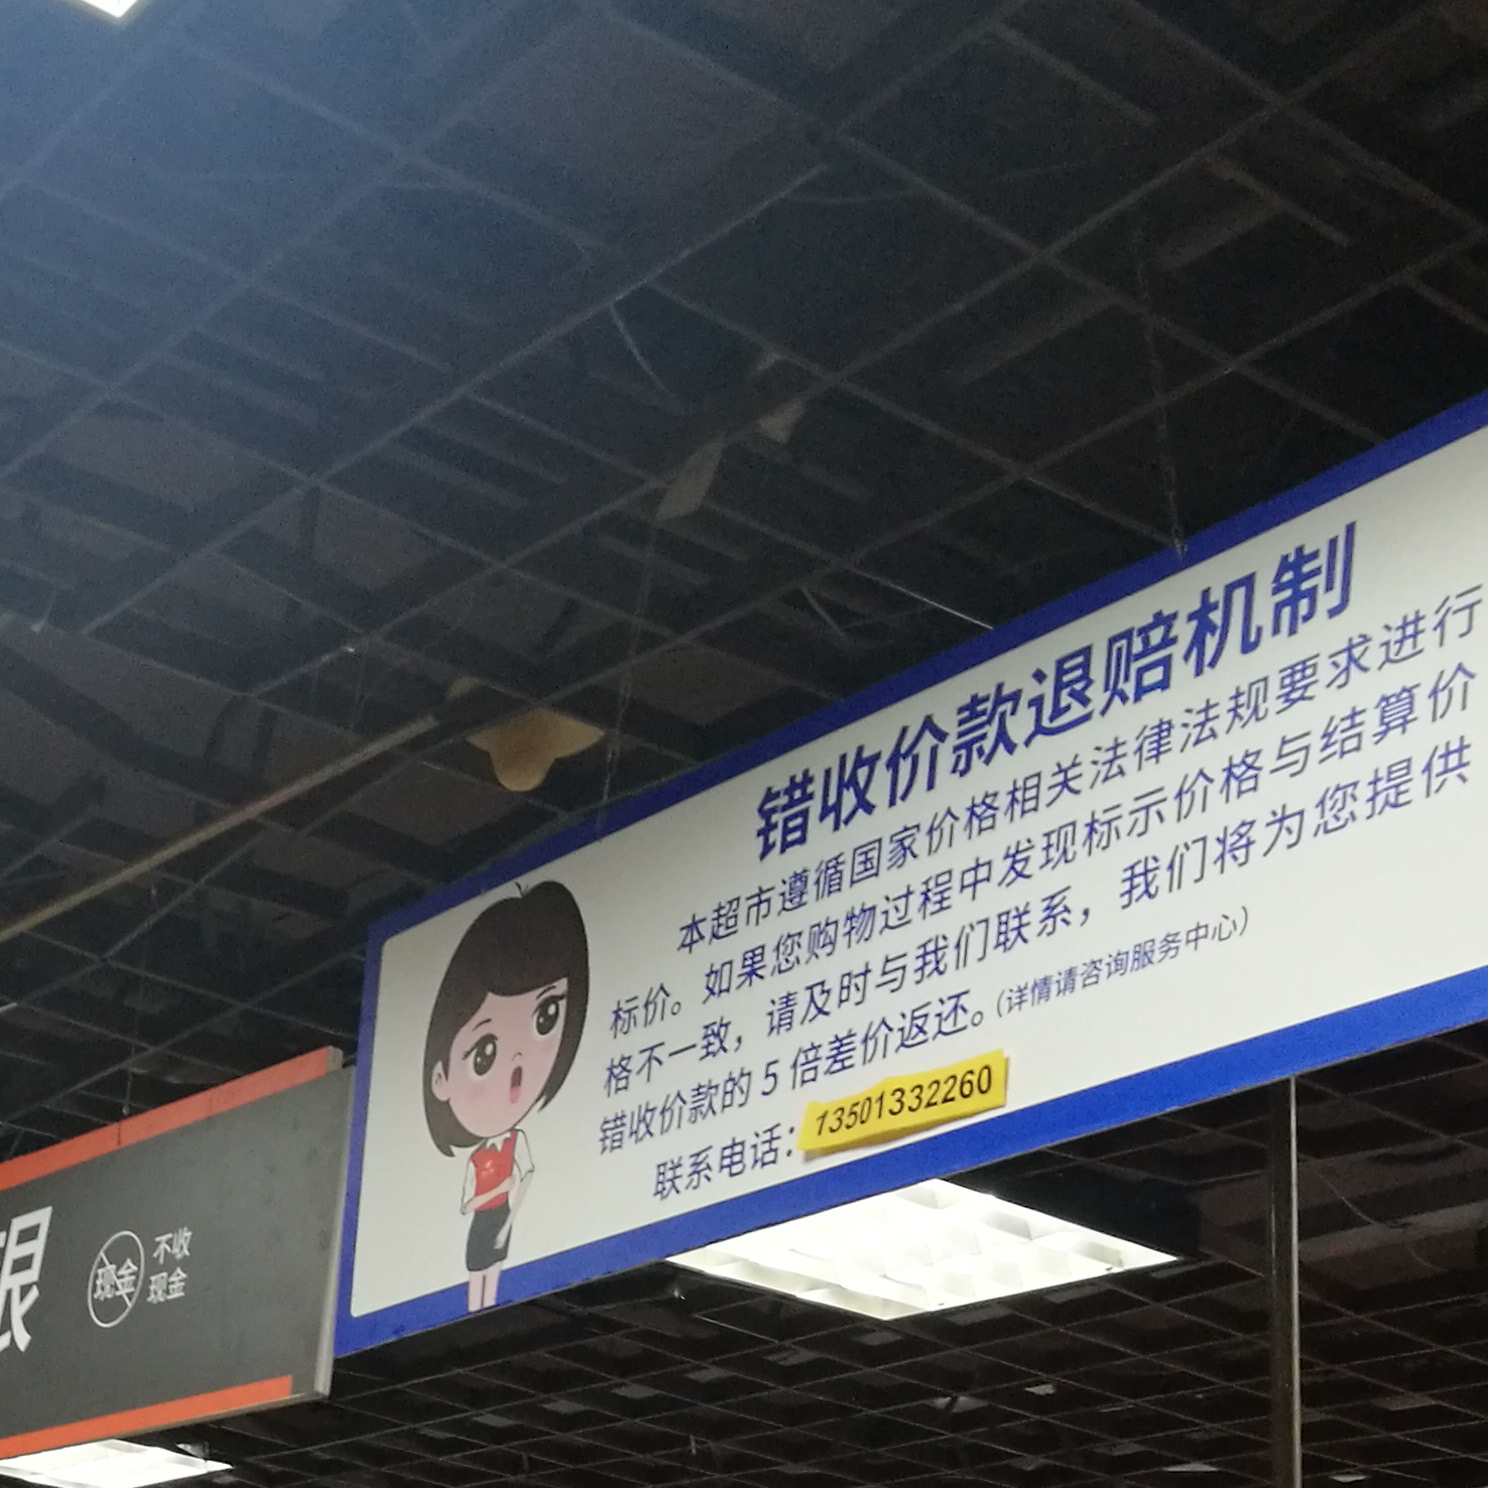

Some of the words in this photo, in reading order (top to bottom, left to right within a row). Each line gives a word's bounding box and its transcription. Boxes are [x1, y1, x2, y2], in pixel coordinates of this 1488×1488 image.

[756, 520, 1357, 862] 错收价款退赔机制
[676, 584, 1483, 955] 本超市遵循国家价格相关法律法规要求进行
[815, 1064, 992, 1136] 13501332260
[153, 1226, 192, 1264] 不收
[147, 1267, 187, 1304] 现金
